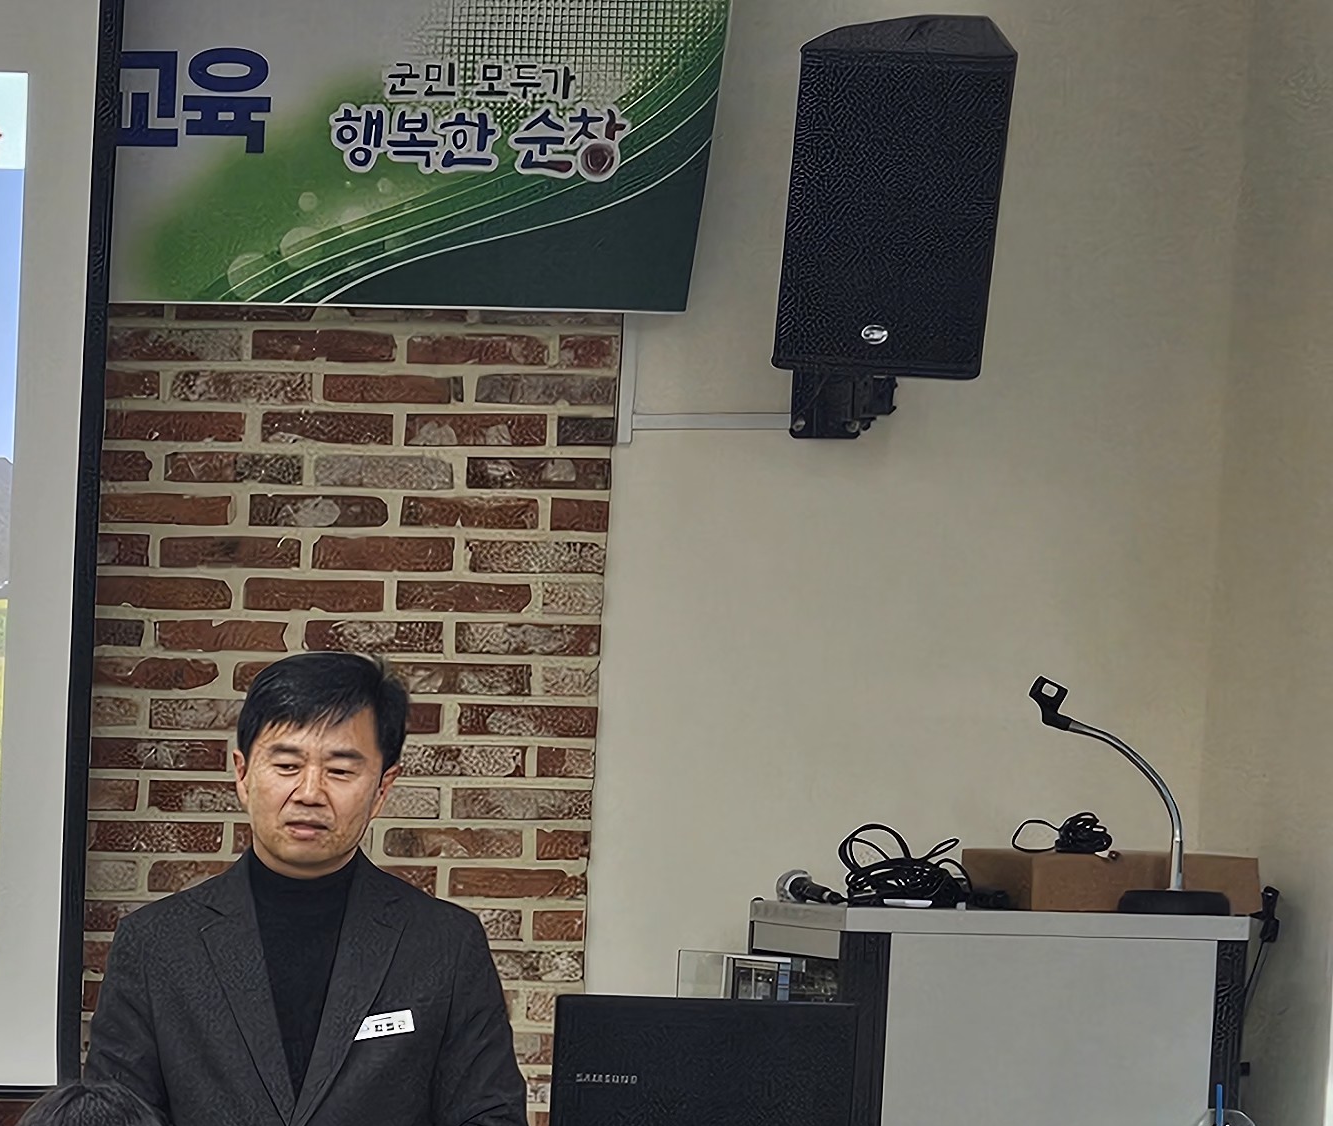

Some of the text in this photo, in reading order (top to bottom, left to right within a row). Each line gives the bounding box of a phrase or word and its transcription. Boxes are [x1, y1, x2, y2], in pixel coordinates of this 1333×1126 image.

[116, 46, 271, 153] 교육
[386, 62, 576, 100] 군민 모두가
[334, 106, 628, 178] 행복한 순창
